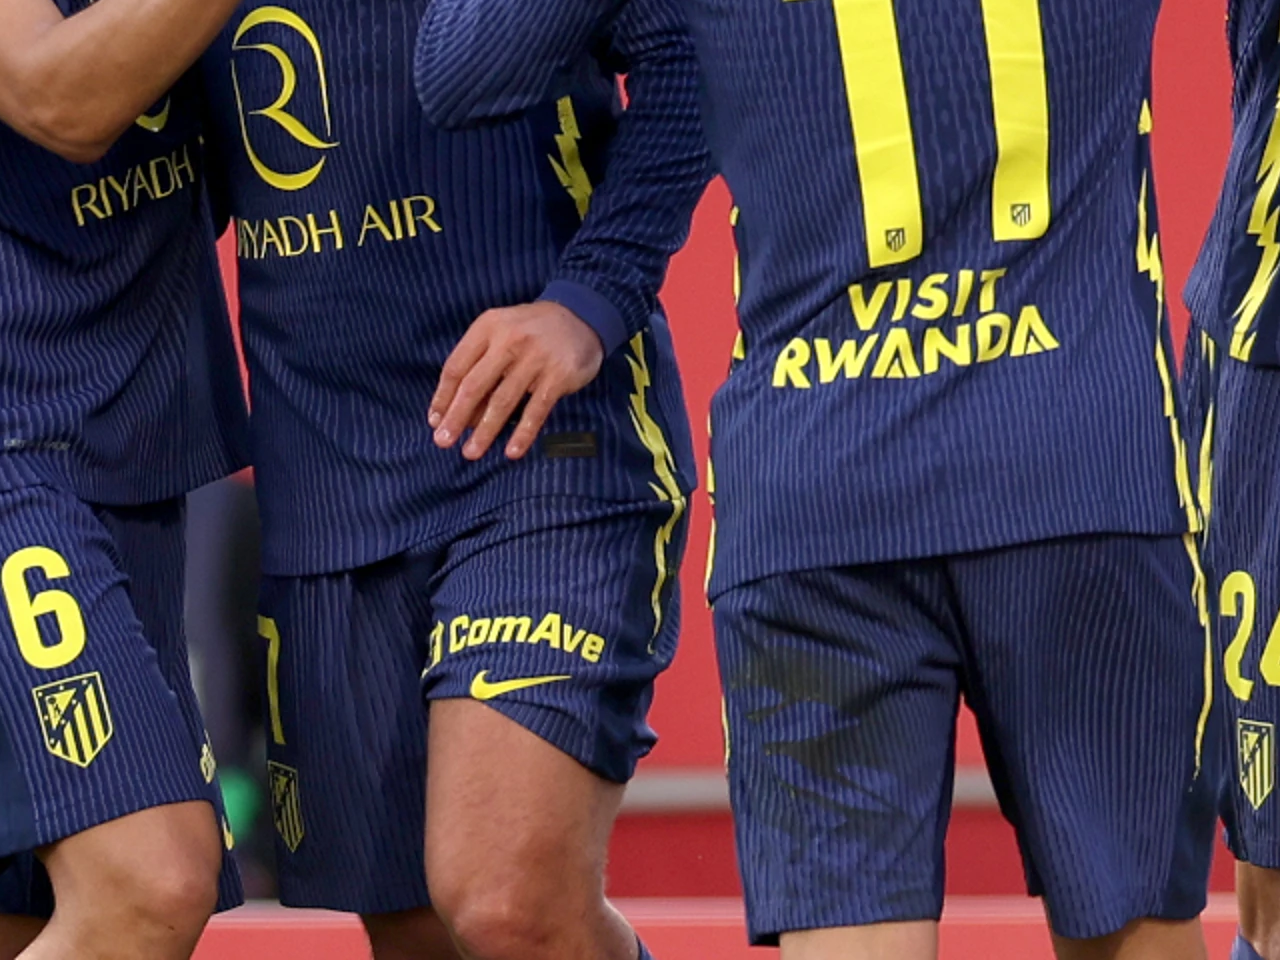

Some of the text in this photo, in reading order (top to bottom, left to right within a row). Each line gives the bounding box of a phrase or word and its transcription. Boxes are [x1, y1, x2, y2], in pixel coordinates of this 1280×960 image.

[70, 143, 196, 227] RIYADH
[237, 194, 443, 260] IYADH AIR
[847, 268, 1008, 332] VISIT
[771, 304, 1060, 389] RWANDA
[0, 545, 87, 670] 6
[448, 611, 606, 664] ComAve
